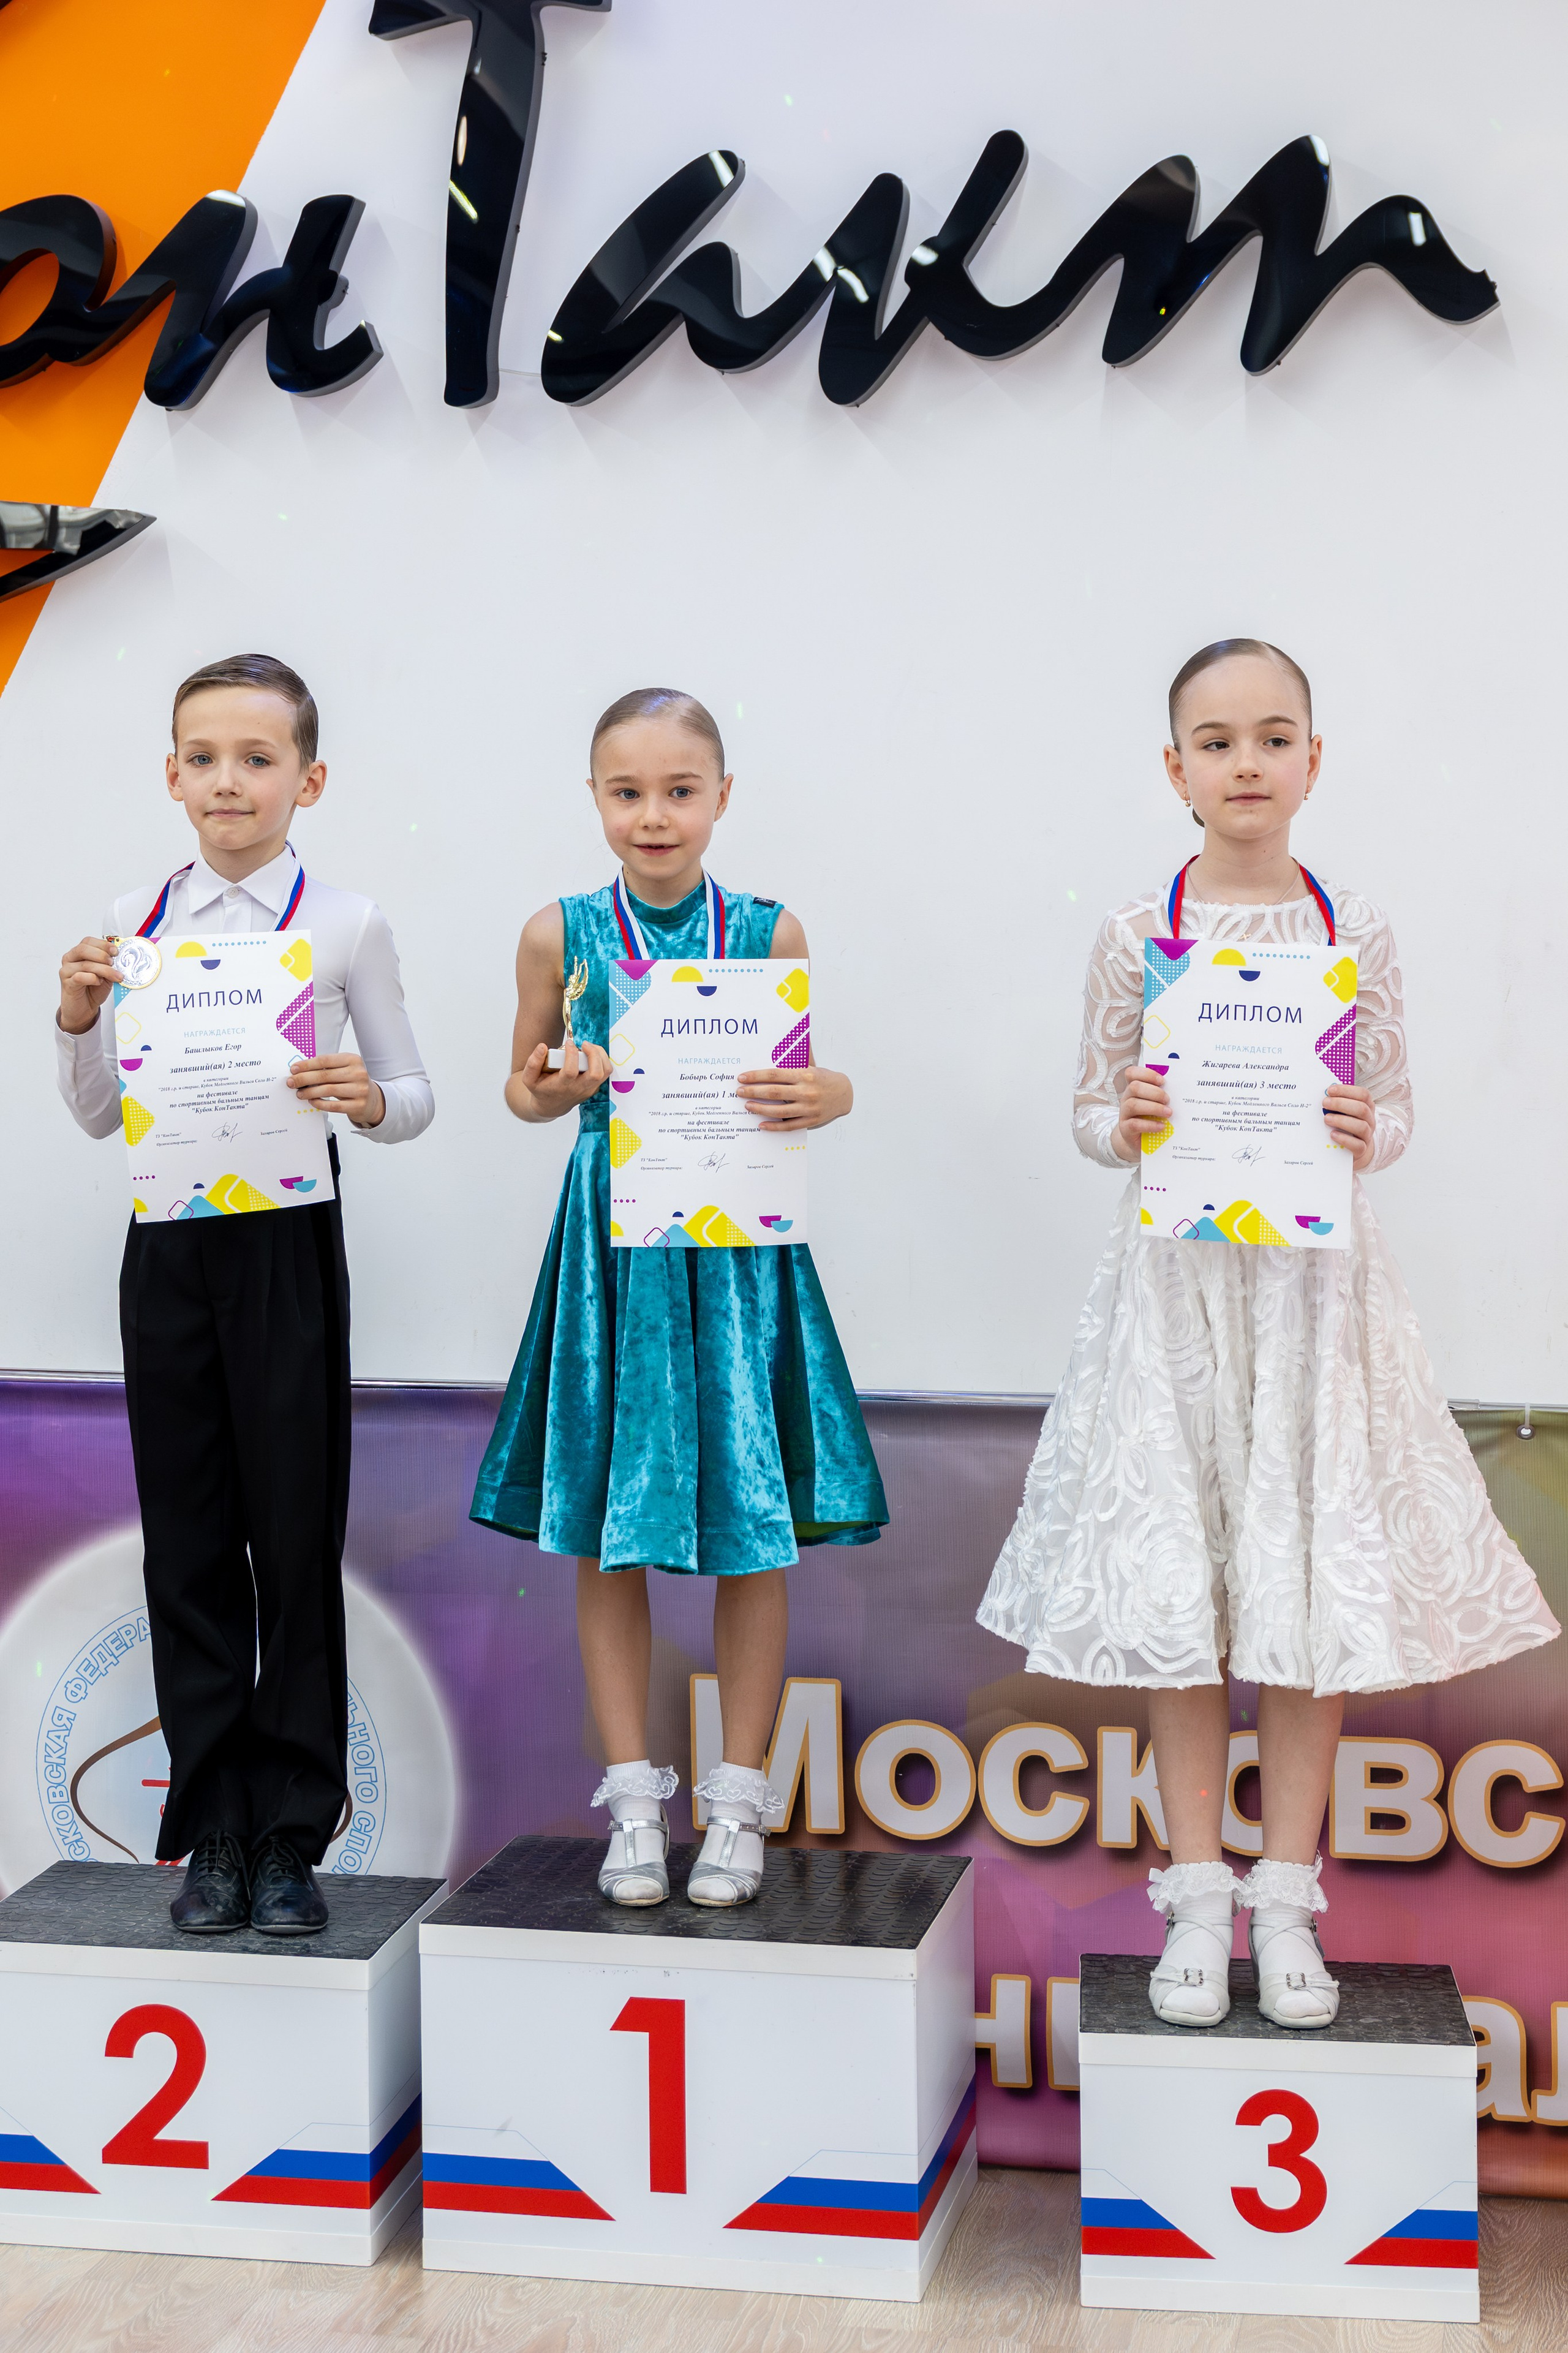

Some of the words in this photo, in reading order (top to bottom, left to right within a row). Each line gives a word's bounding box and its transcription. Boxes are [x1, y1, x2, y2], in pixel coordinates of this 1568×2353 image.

[0, 0, 1499, 412] онТакт
[166, 989, 262, 1013] ДИПЛОМ
[1198, 1003, 1302, 1024] ДИПЛОМ
[184, 1027, 246, 1038] НАГРАЖДАЕТСЯ
[660, 1018, 758, 1038] ДИПЛОМ
[184, 1045, 222, 1054] Башлыков
[1215, 1044, 1282, 1054] НАГРАЖДАЕТСЯ
[170, 1062, 225, 1074] занявший(ая)
[1202, 1060, 1240, 1070] Жигарева
[1242, 1062, 1289, 1072] Александра
[679, 1073, 707, 1082] Бобырь
[710, 1073, 734, 1082] София
[1196, 1080, 1257, 1089] занявший(ая)
[205, 1090, 238, 1099] фестивале
[662, 1090, 719, 1100] занявший(ая)
[178, 1100, 216, 1108] спортивным
[214, 1103, 249, 1112] КонТакта"
[44, 1706, 98, 1862] СКОВСКАЯ
[331, 1810, 375, 1875] СПО
[101, 2003, 209, 2170] 2
[610, 1996, 687, 2194] 1
[1231, 2088, 1327, 2233] 3
